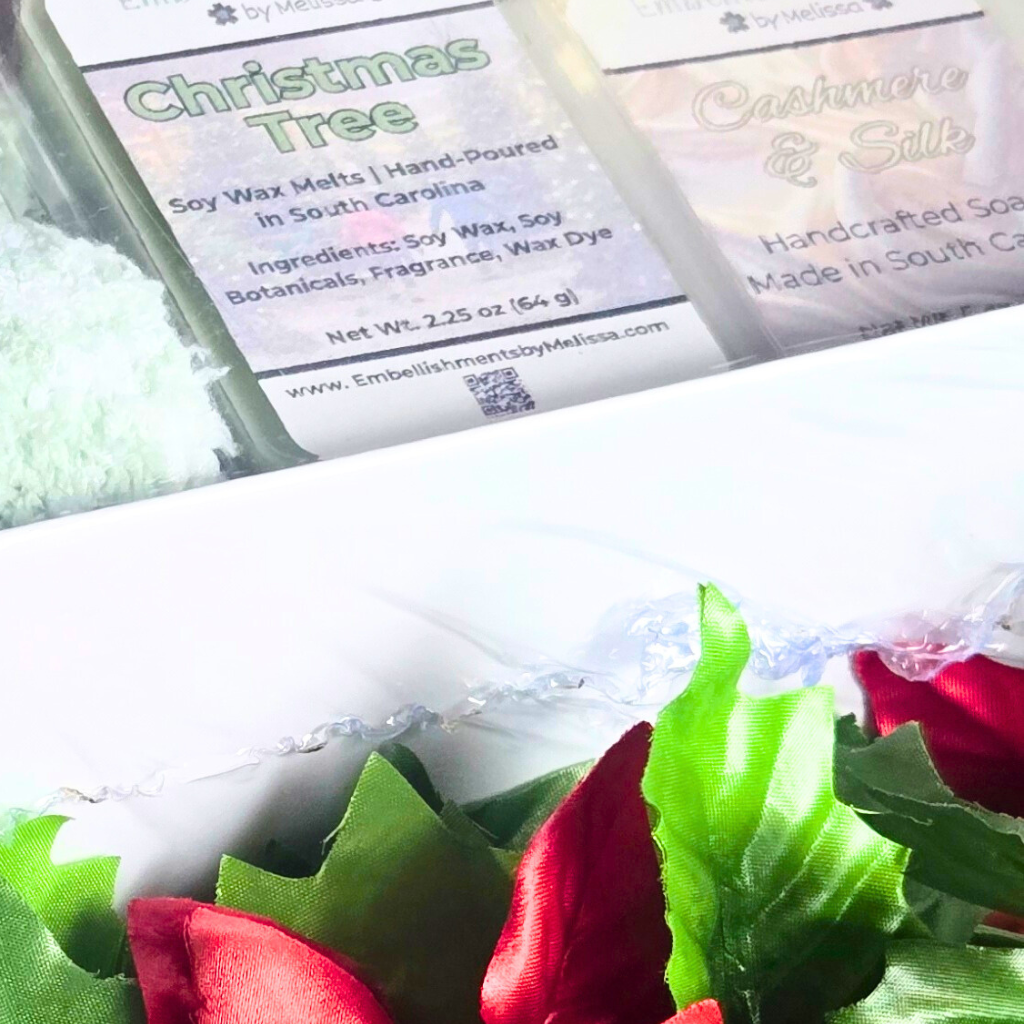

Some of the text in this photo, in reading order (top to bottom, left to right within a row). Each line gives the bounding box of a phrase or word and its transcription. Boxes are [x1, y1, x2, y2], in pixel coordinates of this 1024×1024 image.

[242, 1, 272, 24] by
[750, 12, 778, 32] by
[123, 38, 491, 124] Christmas
[692, 64, 970, 132] Cashmere
[245, 101, 419, 154] Tree
[763, 117, 976, 189] & Silk
[169, 196, 218, 214] Soy
[222, 185, 285, 205] Wax
[290, 170, 366, 195] Melts
[383, 134, 559, 180] Hand-Poured
[254, 179, 486, 228] in South Carolina
[248, 210, 563, 277] Ingredients: Soy Wax, Soy
[758, 201, 964, 255] Handcrafted
[225, 227, 614, 306] Botanicals, Fragrance, Wax Dye
[747, 264, 843, 295] Made
[847, 258, 883, 278] in
[885, 238, 986, 272] South
[325, 287, 580, 346] Net Wt. 2.25 oz (64 g)
[285, 320, 671, 400] www. EmbellishmentsbyMelissa.com
